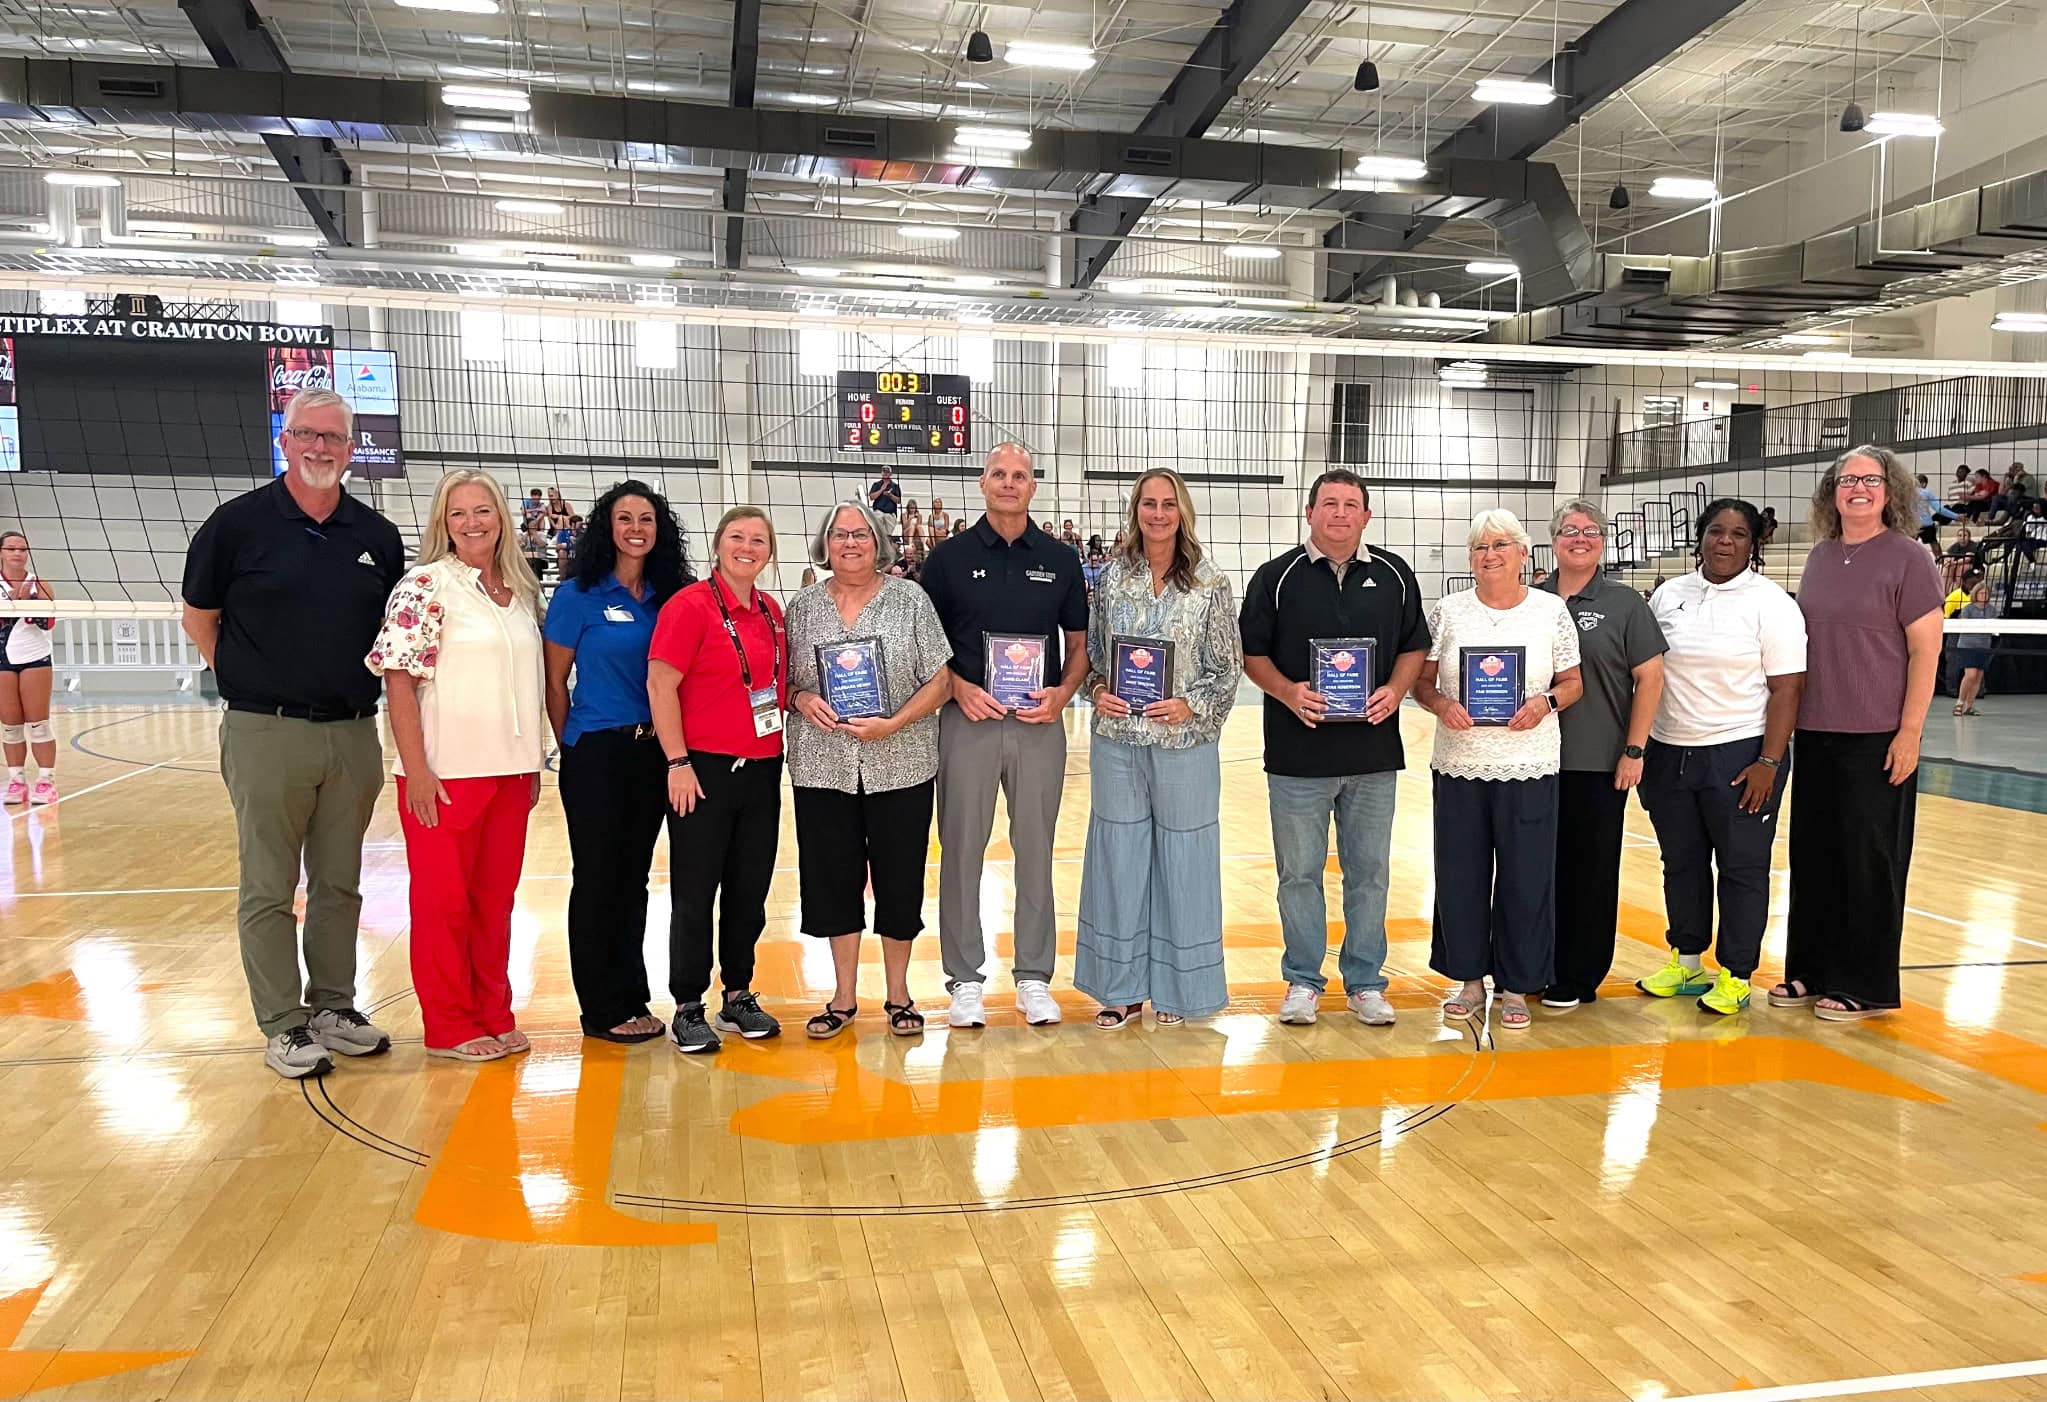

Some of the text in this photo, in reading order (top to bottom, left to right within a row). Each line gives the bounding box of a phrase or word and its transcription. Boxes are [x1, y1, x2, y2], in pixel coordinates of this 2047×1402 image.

[0, 316, 330, 345] TIPLEX AT CRAMTON BOWL
[347, 383, 386, 392] Alabama
[847, 393, 962, 405] HOME GUEST
[861, 403, 964, 425] 0 3 0
[360, 431, 376, 447] R
[849, 429, 964, 447] 2 2 2 0
